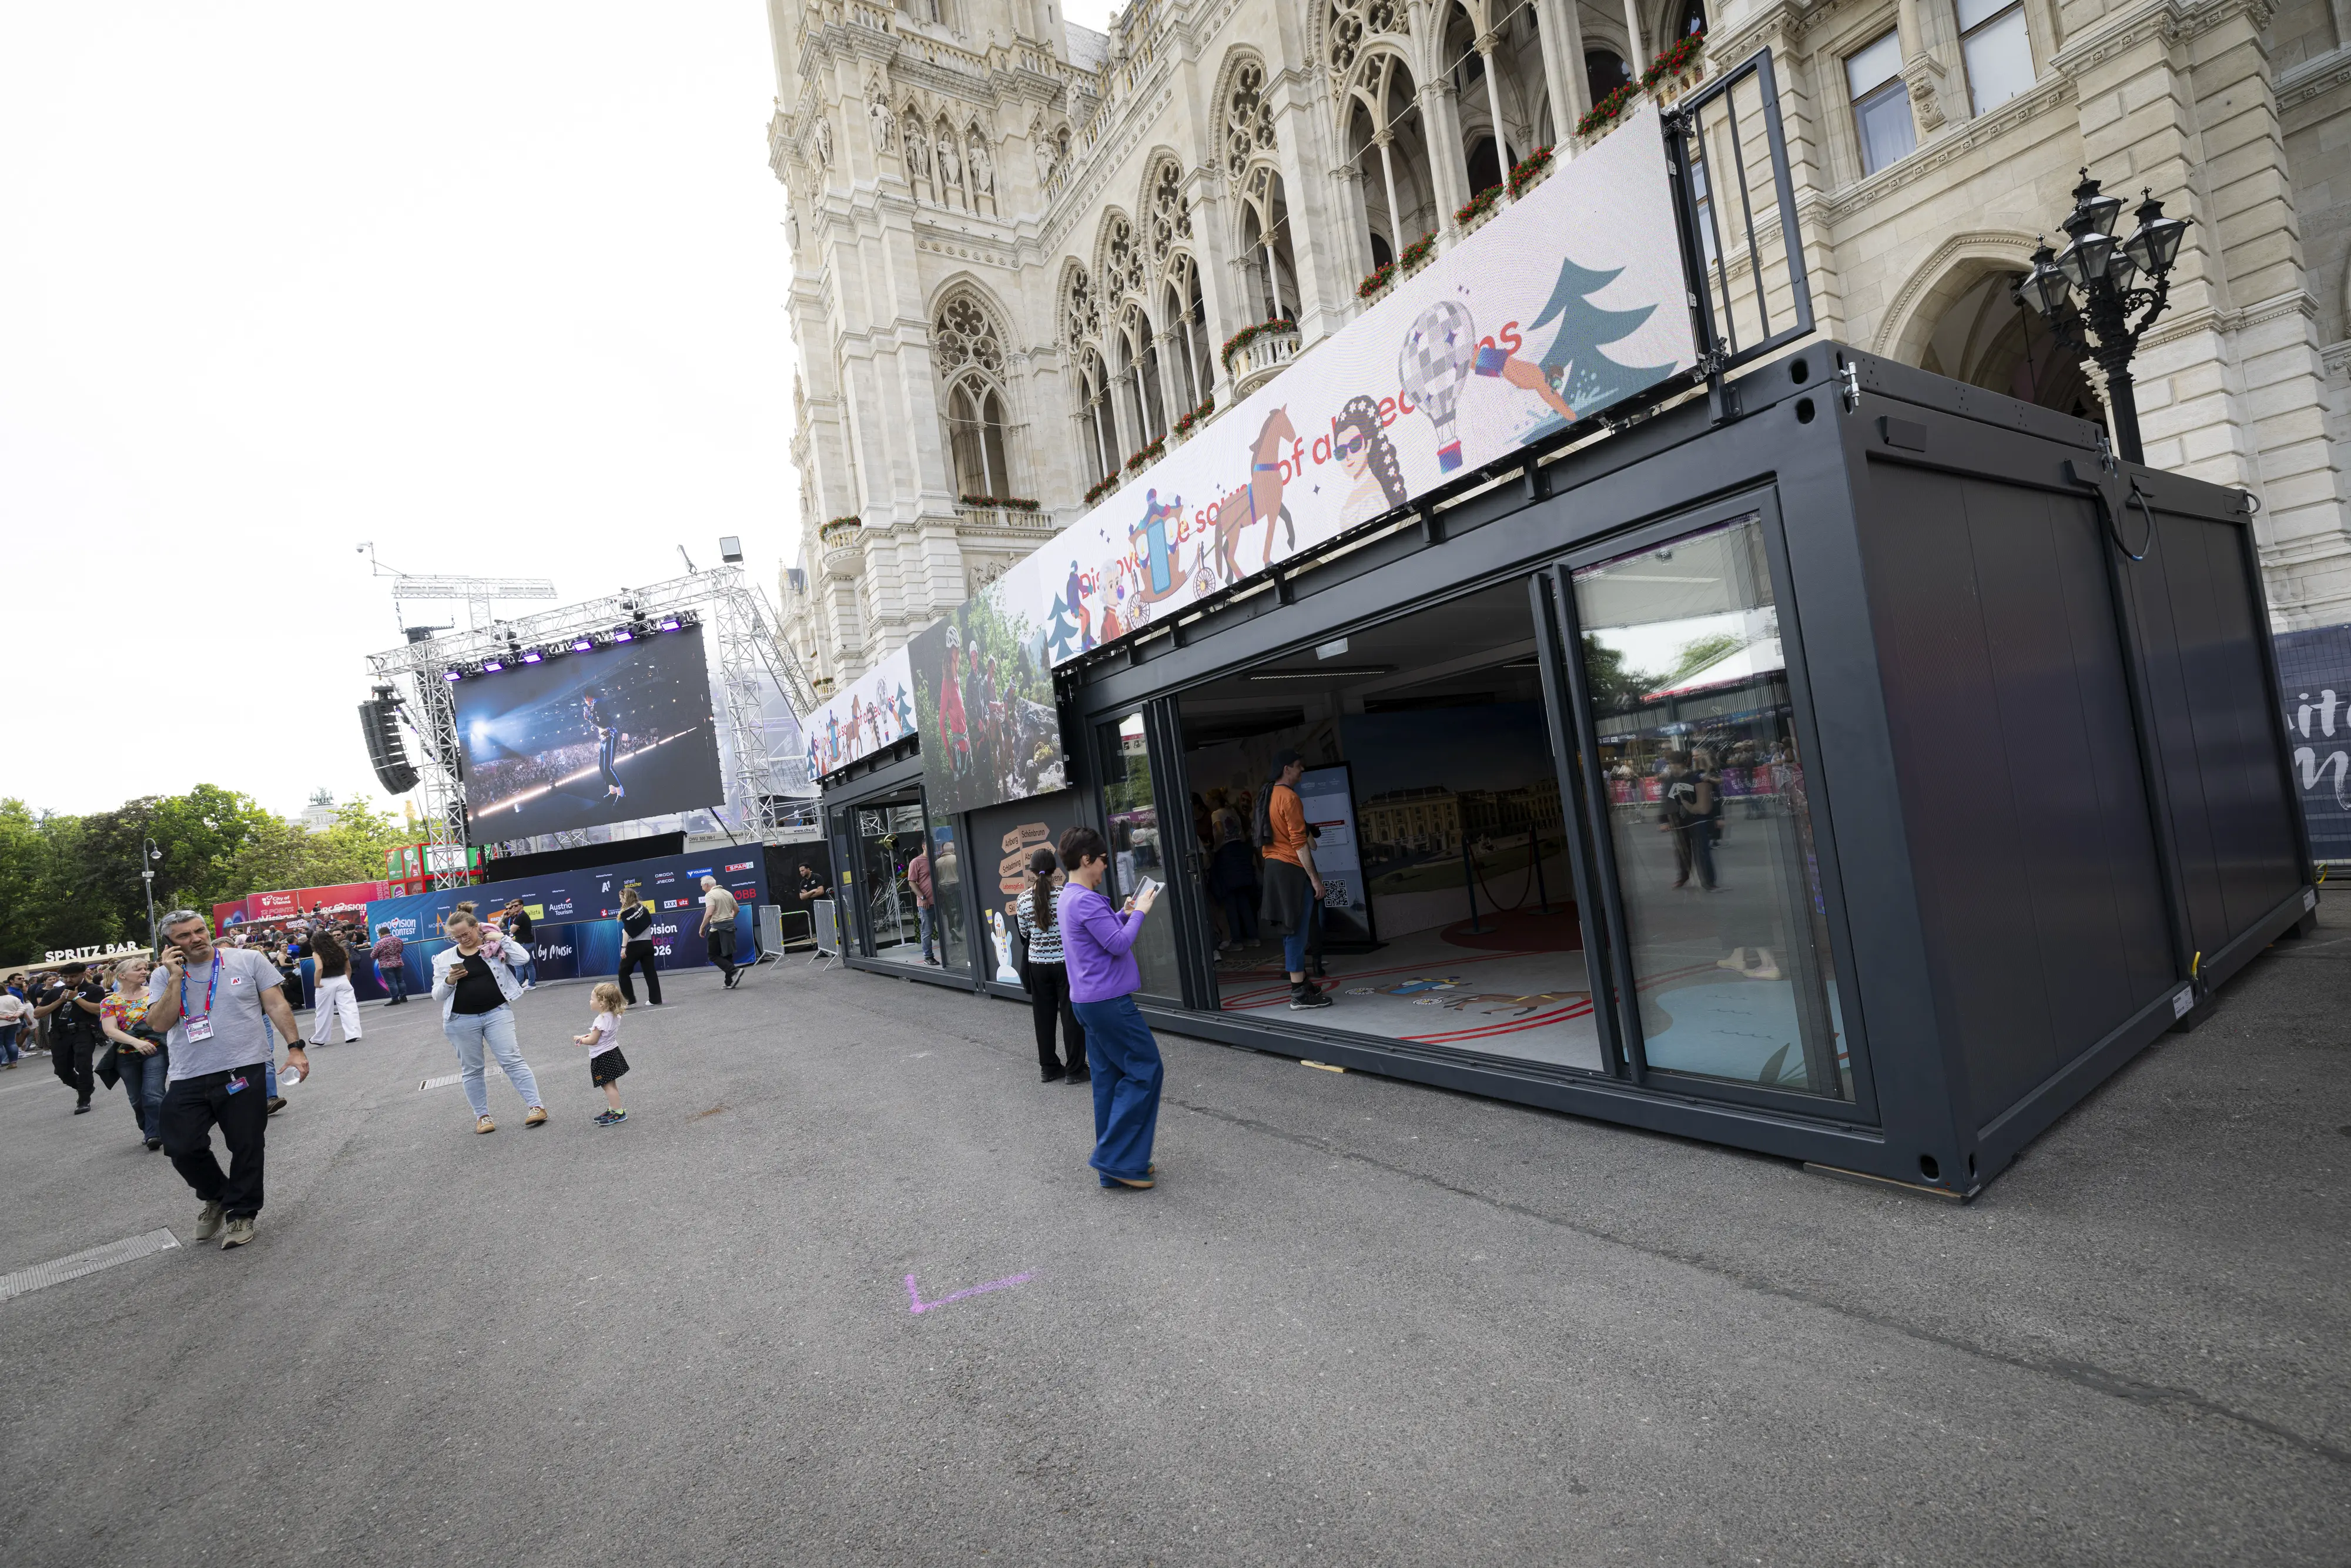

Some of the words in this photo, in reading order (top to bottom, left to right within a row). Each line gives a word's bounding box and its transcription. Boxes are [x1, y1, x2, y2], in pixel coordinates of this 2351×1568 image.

[1022, 828, 1046, 838] Schönbrunn
[1005, 836, 1019, 848] Arlberg
[1003, 859, 1022, 873] Schladming
[602, 880, 611, 893] A1
[549, 902, 572, 911] Austria
[391, 928, 416, 937] CONTEST
[45, 945, 101, 962] SPRITZ
[105, 941, 138, 954] BAR
[550, 944, 572, 959] Music
[654, 945, 672, 956] 026
